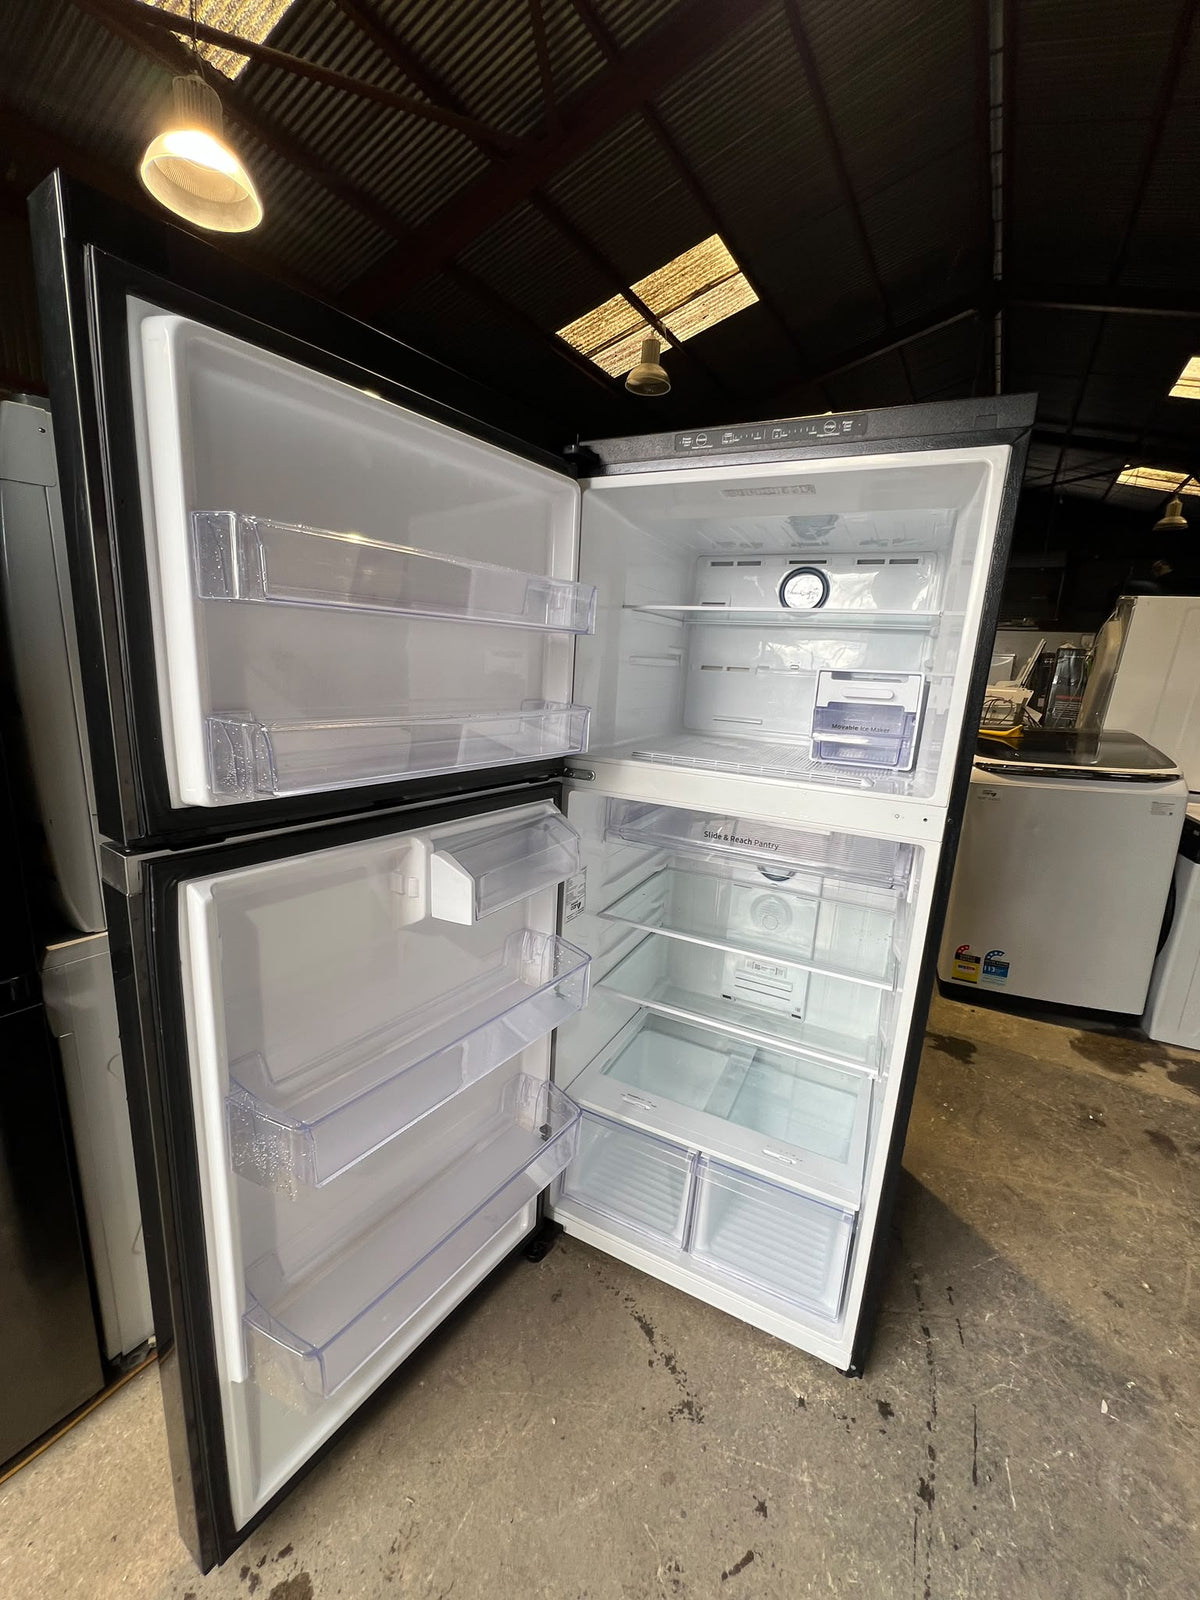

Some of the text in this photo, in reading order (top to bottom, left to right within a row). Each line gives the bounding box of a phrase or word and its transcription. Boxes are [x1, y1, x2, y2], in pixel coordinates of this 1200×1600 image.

[831, 723, 859, 731] Movable
[703, 830, 723, 840] Slide
[730, 835, 753, 846] Reach
[753, 839, 779, 851] Pantry
